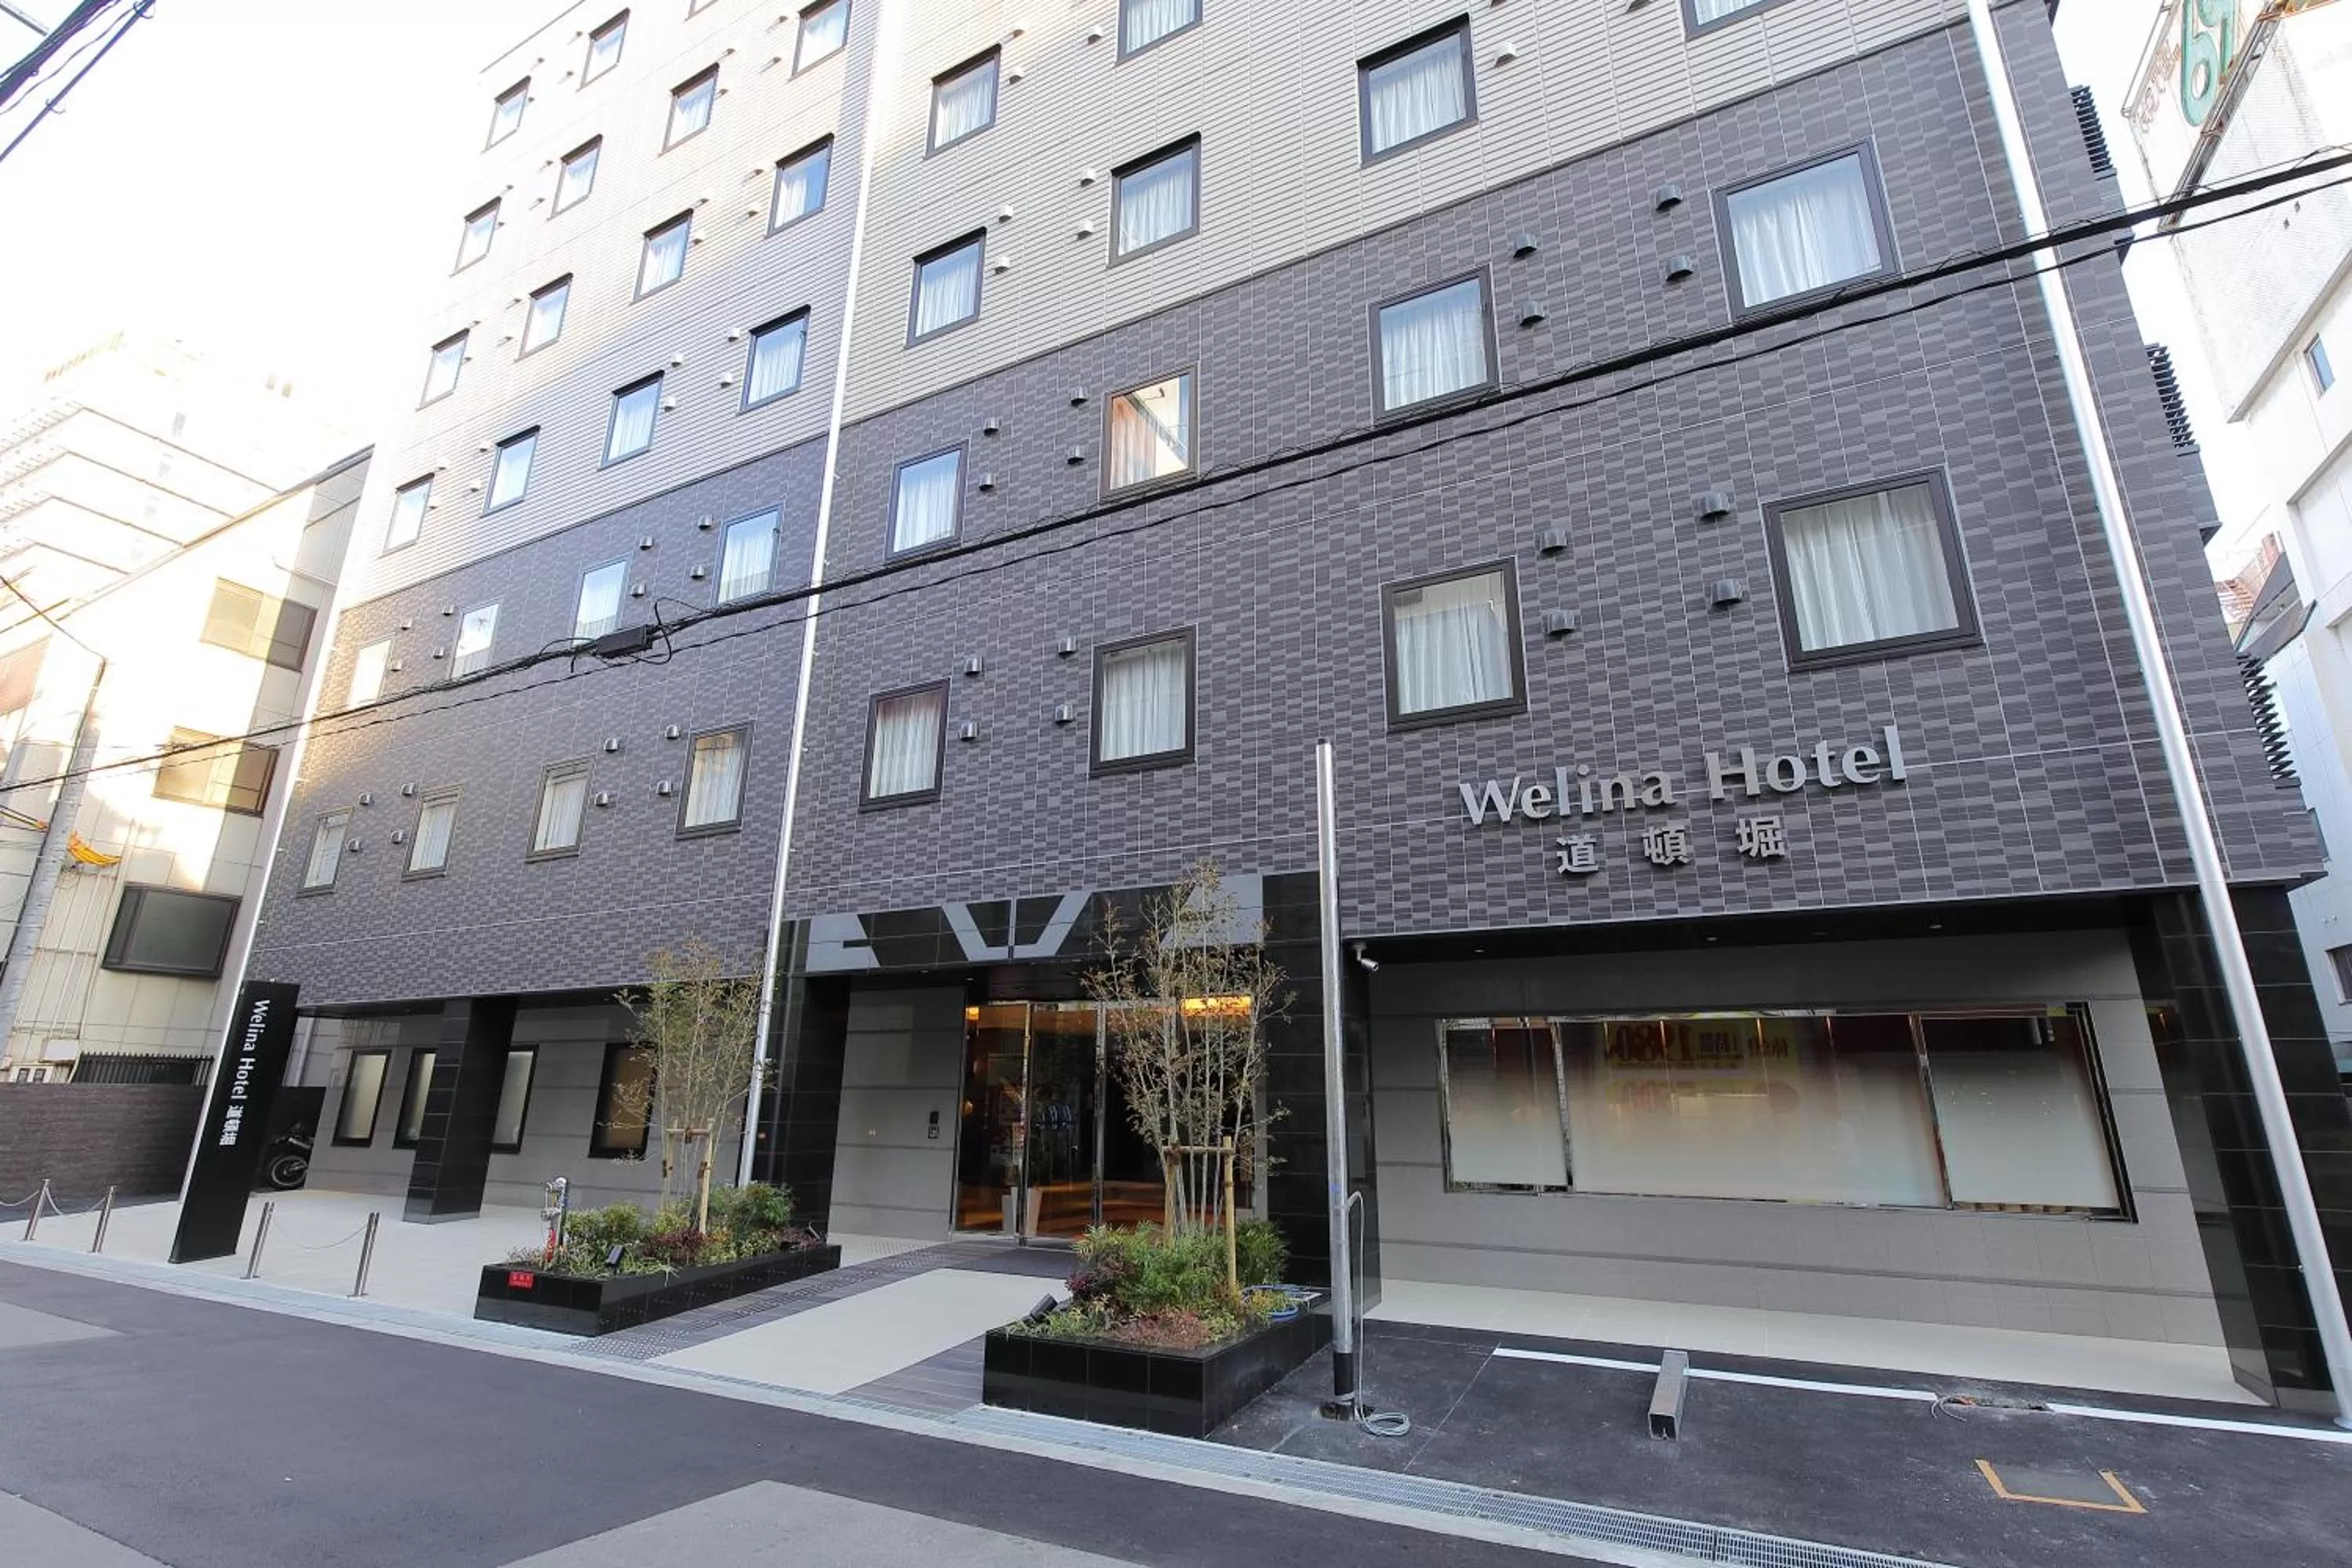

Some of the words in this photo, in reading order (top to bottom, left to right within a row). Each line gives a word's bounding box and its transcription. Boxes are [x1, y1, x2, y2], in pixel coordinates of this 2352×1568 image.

[1459, 765, 1675, 826] Welina
[1705, 725, 1907, 800] Hotel
[1556, 816, 1788, 875] 道頓堀
[243, 999, 270, 1051] Welina
[230, 1058, 256, 1100] Hotel
